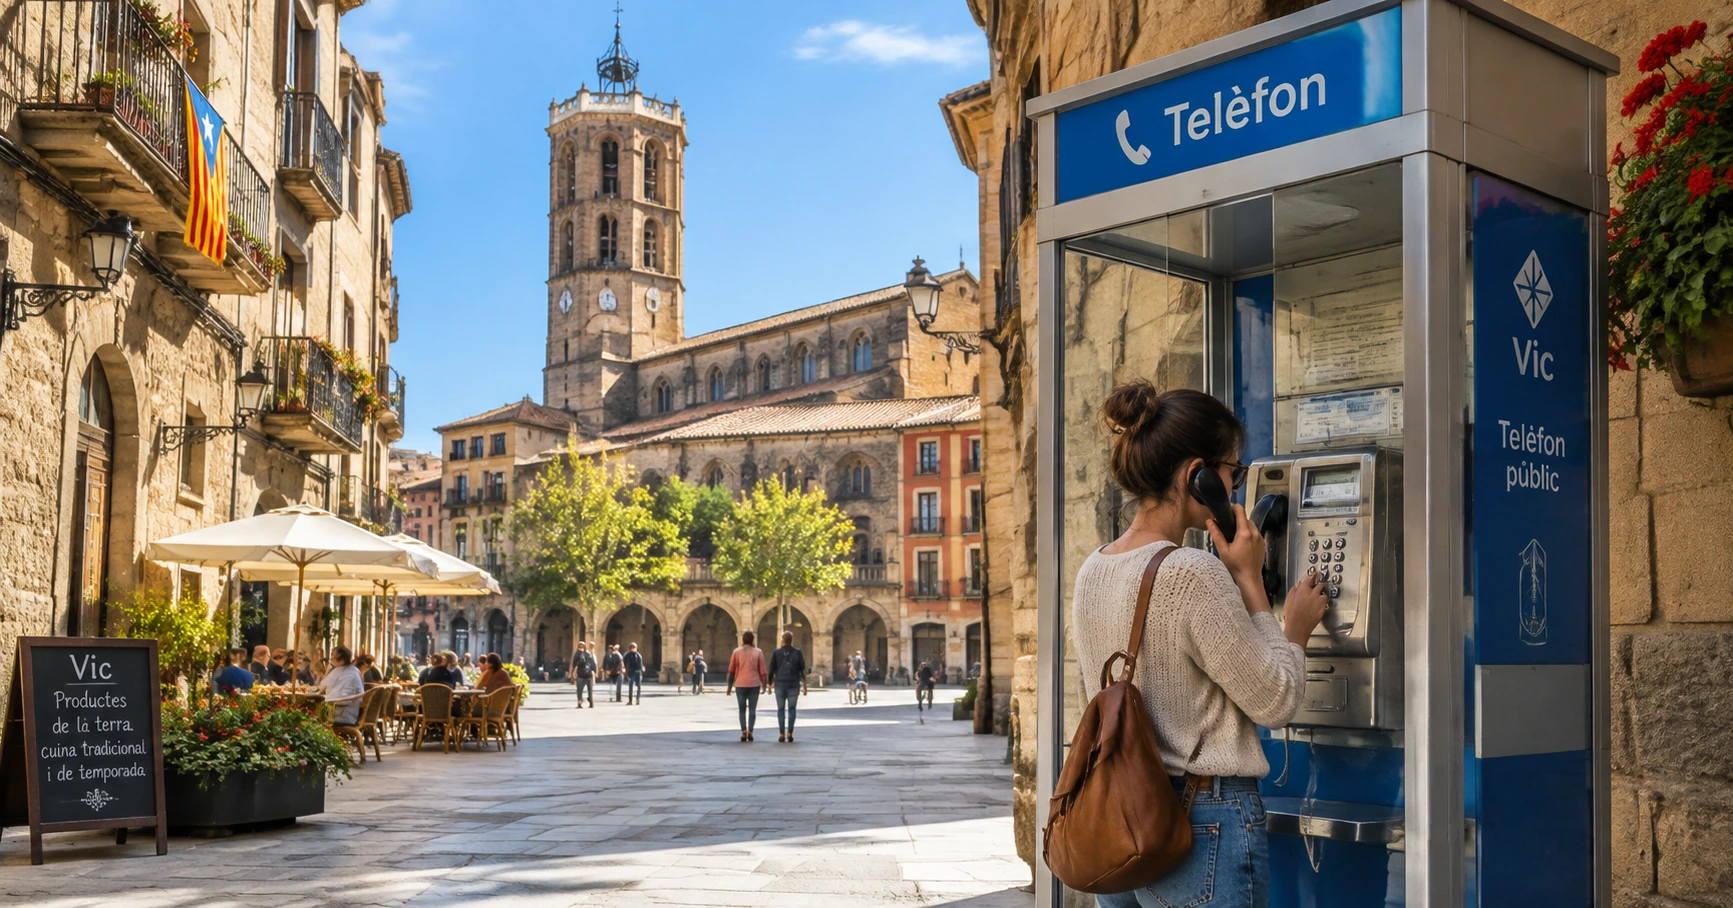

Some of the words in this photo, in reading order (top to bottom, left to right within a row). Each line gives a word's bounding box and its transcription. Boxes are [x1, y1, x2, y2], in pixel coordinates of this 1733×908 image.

[1164, 73, 1326, 146] Telèfon
[1512, 336, 1554, 381] Vic
[69, 654, 112, 680] Vic
[54, 690, 127, 709] Productes
[52, 716, 69, 734] de
[41, 743, 77, 759] cuina
[81, 739, 147, 757] tradicional
[47, 766, 51, 782] i
[57, 764, 74, 782] de
[79, 761, 147, 783] temporada
